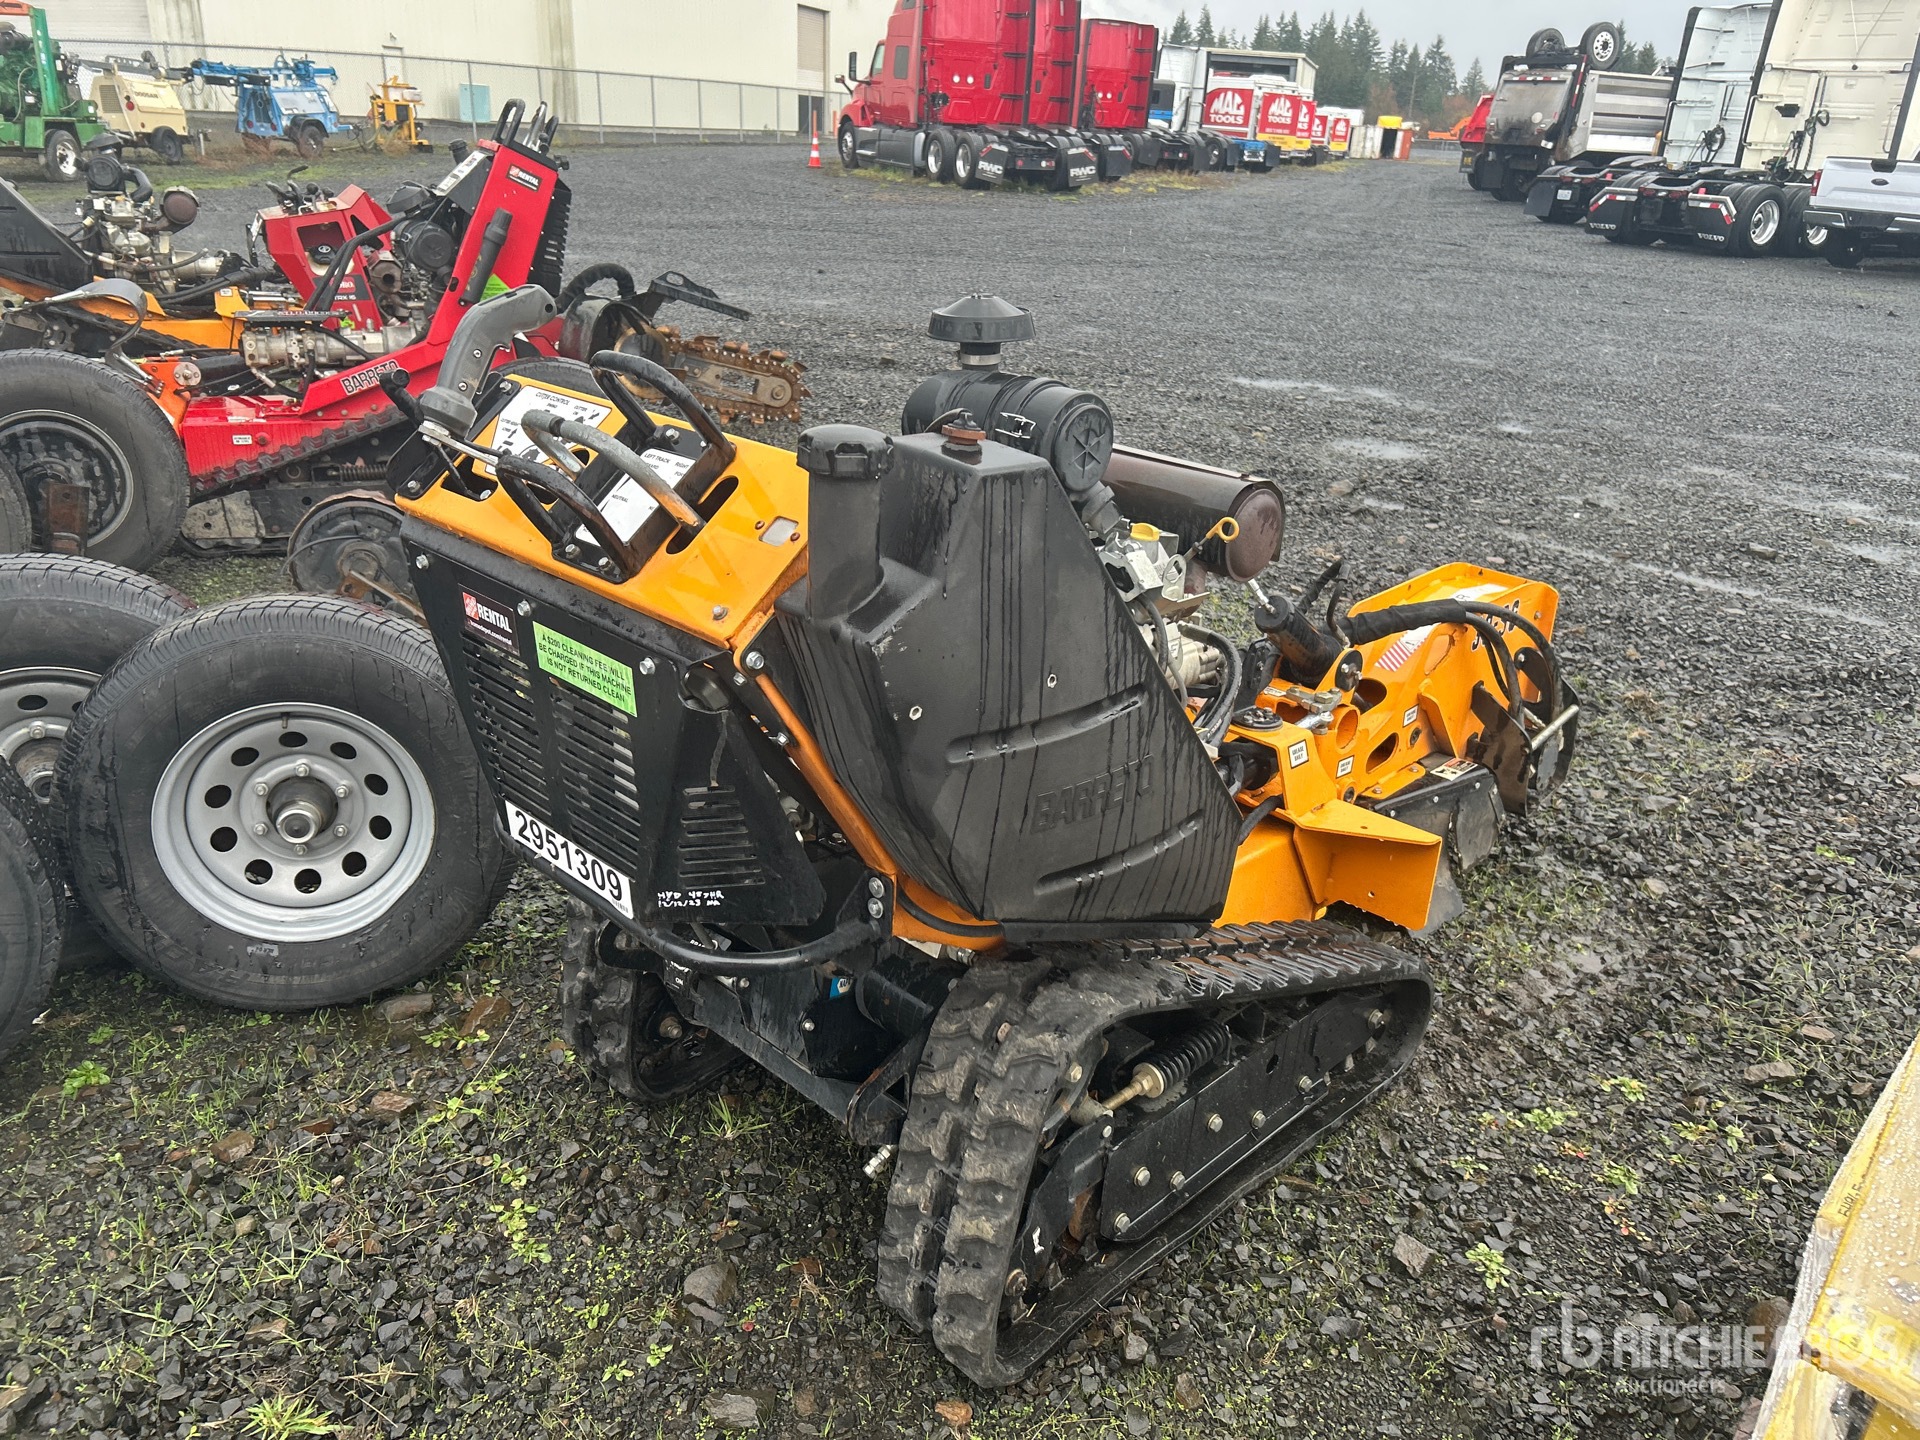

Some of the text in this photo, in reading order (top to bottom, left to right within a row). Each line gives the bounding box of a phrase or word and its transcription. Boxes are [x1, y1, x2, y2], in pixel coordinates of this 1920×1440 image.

[1210, 91, 1245, 115] MAC
[1268, 96, 1293, 117] MAC
[1209, 113, 1245, 125] TOOLS
[1267, 115, 1292, 125] TOOLS
[978, 160, 1004, 175] RWC
[1069, 165, 1097, 178] RWC
[517, 170, 539, 186] RENTAL
[1589, 222, 1617, 231] VOLVO
[1697, 232, 1725, 243] VOLVO
[549, 395, 570, 406] CONTROL
[644, 453, 671, 464] LEFT TRACK
[674, 461, 690, 469] RIGHT
[611, 493, 629, 503] NEUTRAL
[477, 601, 513, 634] RENTAL
[542, 633, 626, 681] A $200 CLEANING FEE WILL
[538, 643, 633, 696] BE CHARGED IF THIS MACHINE
[546, 657, 625, 702] IS NOT RETURNED CLEAN
[515, 810, 623, 902] 2951309
[657, 890, 682, 901] HYD
